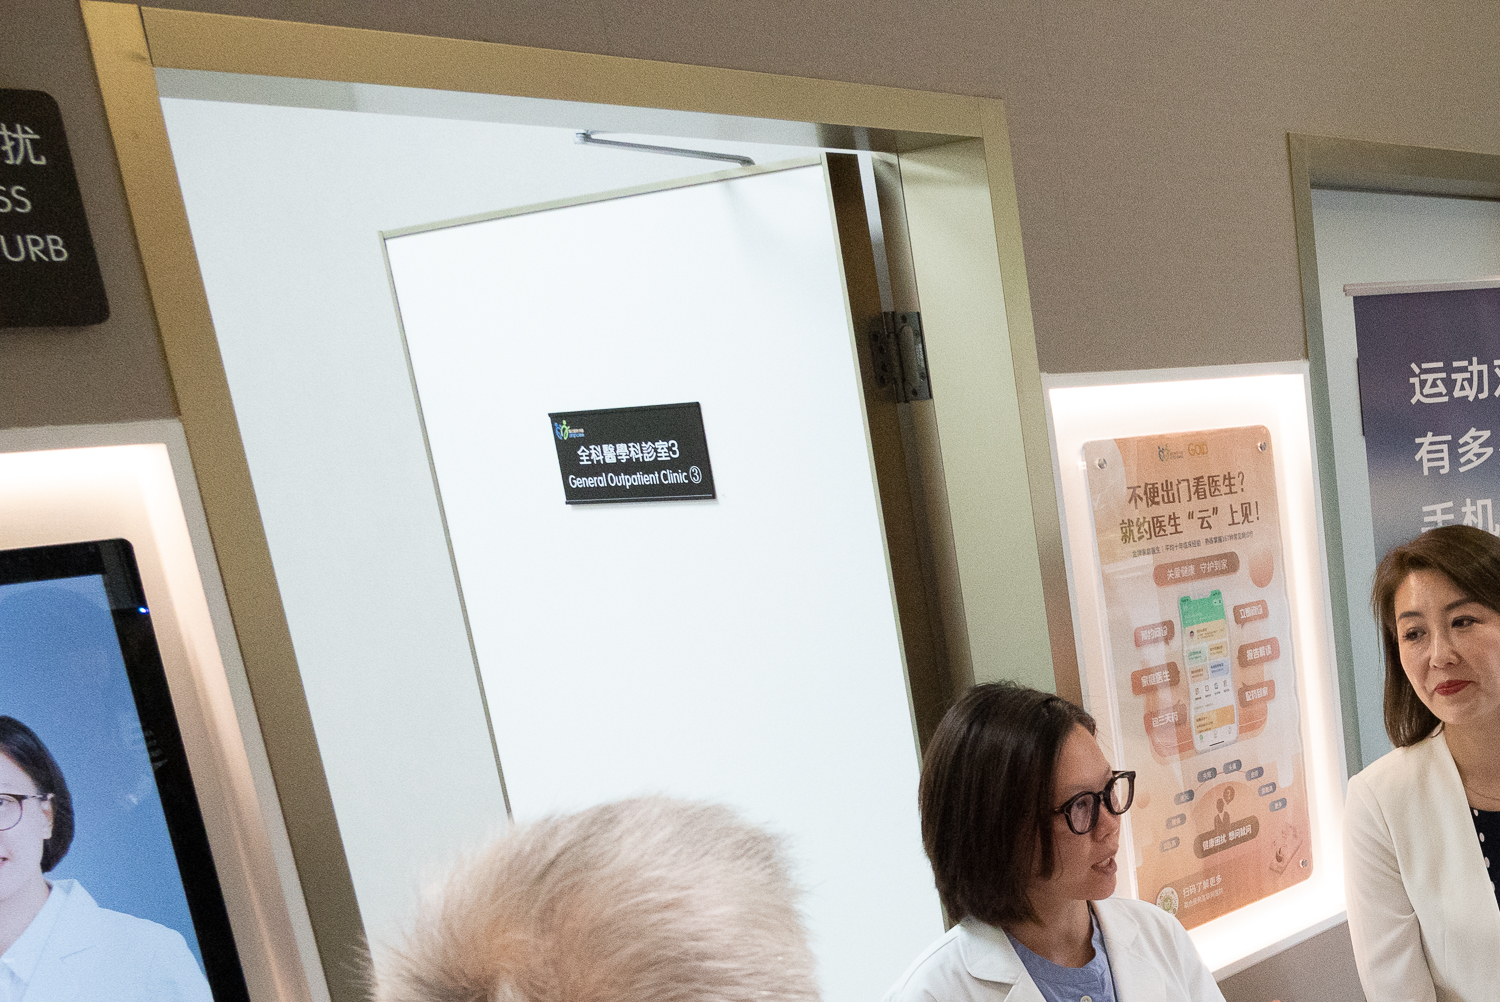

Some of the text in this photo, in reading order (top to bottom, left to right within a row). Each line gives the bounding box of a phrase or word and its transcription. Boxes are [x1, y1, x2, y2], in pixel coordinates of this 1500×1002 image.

[577, 440, 680, 465] 全科醫學科診室3
[568, 473, 608, 489] General
[607, 470, 660, 490] Outpatient
[660, 469, 689, 485] Clinic
[1127, 471, 1246, 510] 不便出门看医生？
[1167, 559, 1228, 581] 关爱健康 守护到家
[1141, 670, 1171, 688] 家庭医生
